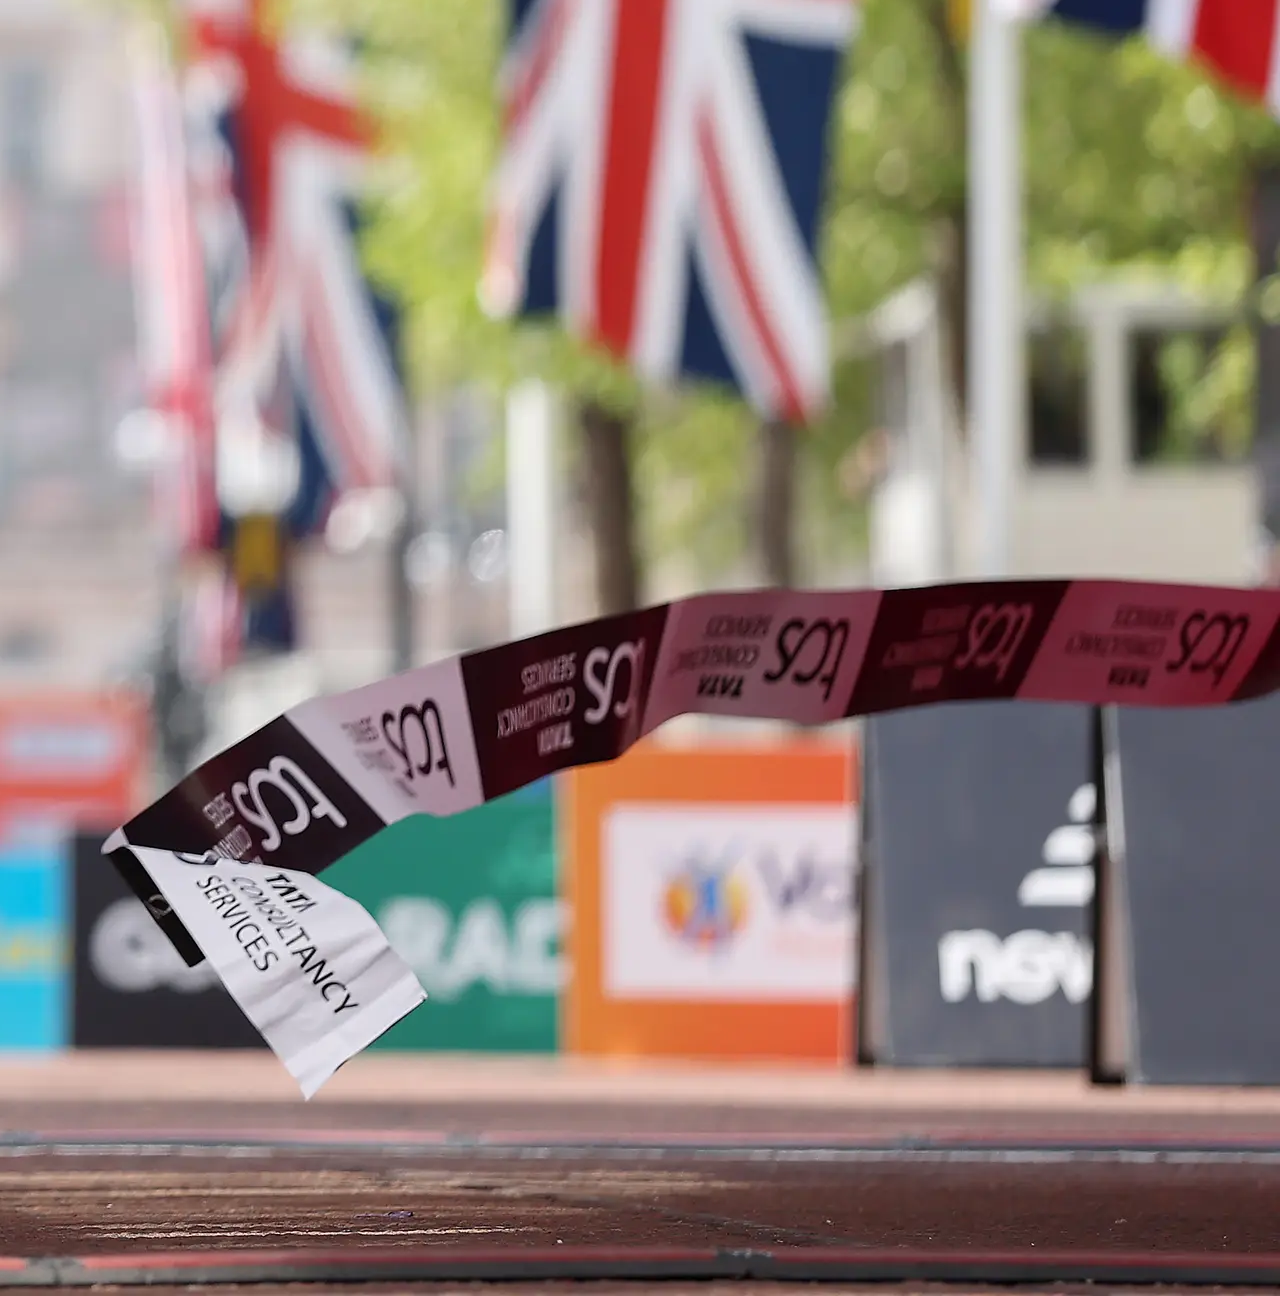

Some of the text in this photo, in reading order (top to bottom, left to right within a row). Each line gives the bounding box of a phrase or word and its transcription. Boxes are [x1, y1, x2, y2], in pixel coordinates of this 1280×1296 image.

[696, 673, 744, 698] TATA
[763, 616, 851, 703] tcs
[1163, 610, 1250, 691] tcs
[381, 697, 457, 789] tcs
[231, 755, 349, 852] tcs
[195, 874, 280, 973] SERVICES
[264, 872, 319, 914] TATA
[231, 875, 360, 1016] CONSULTANCY
